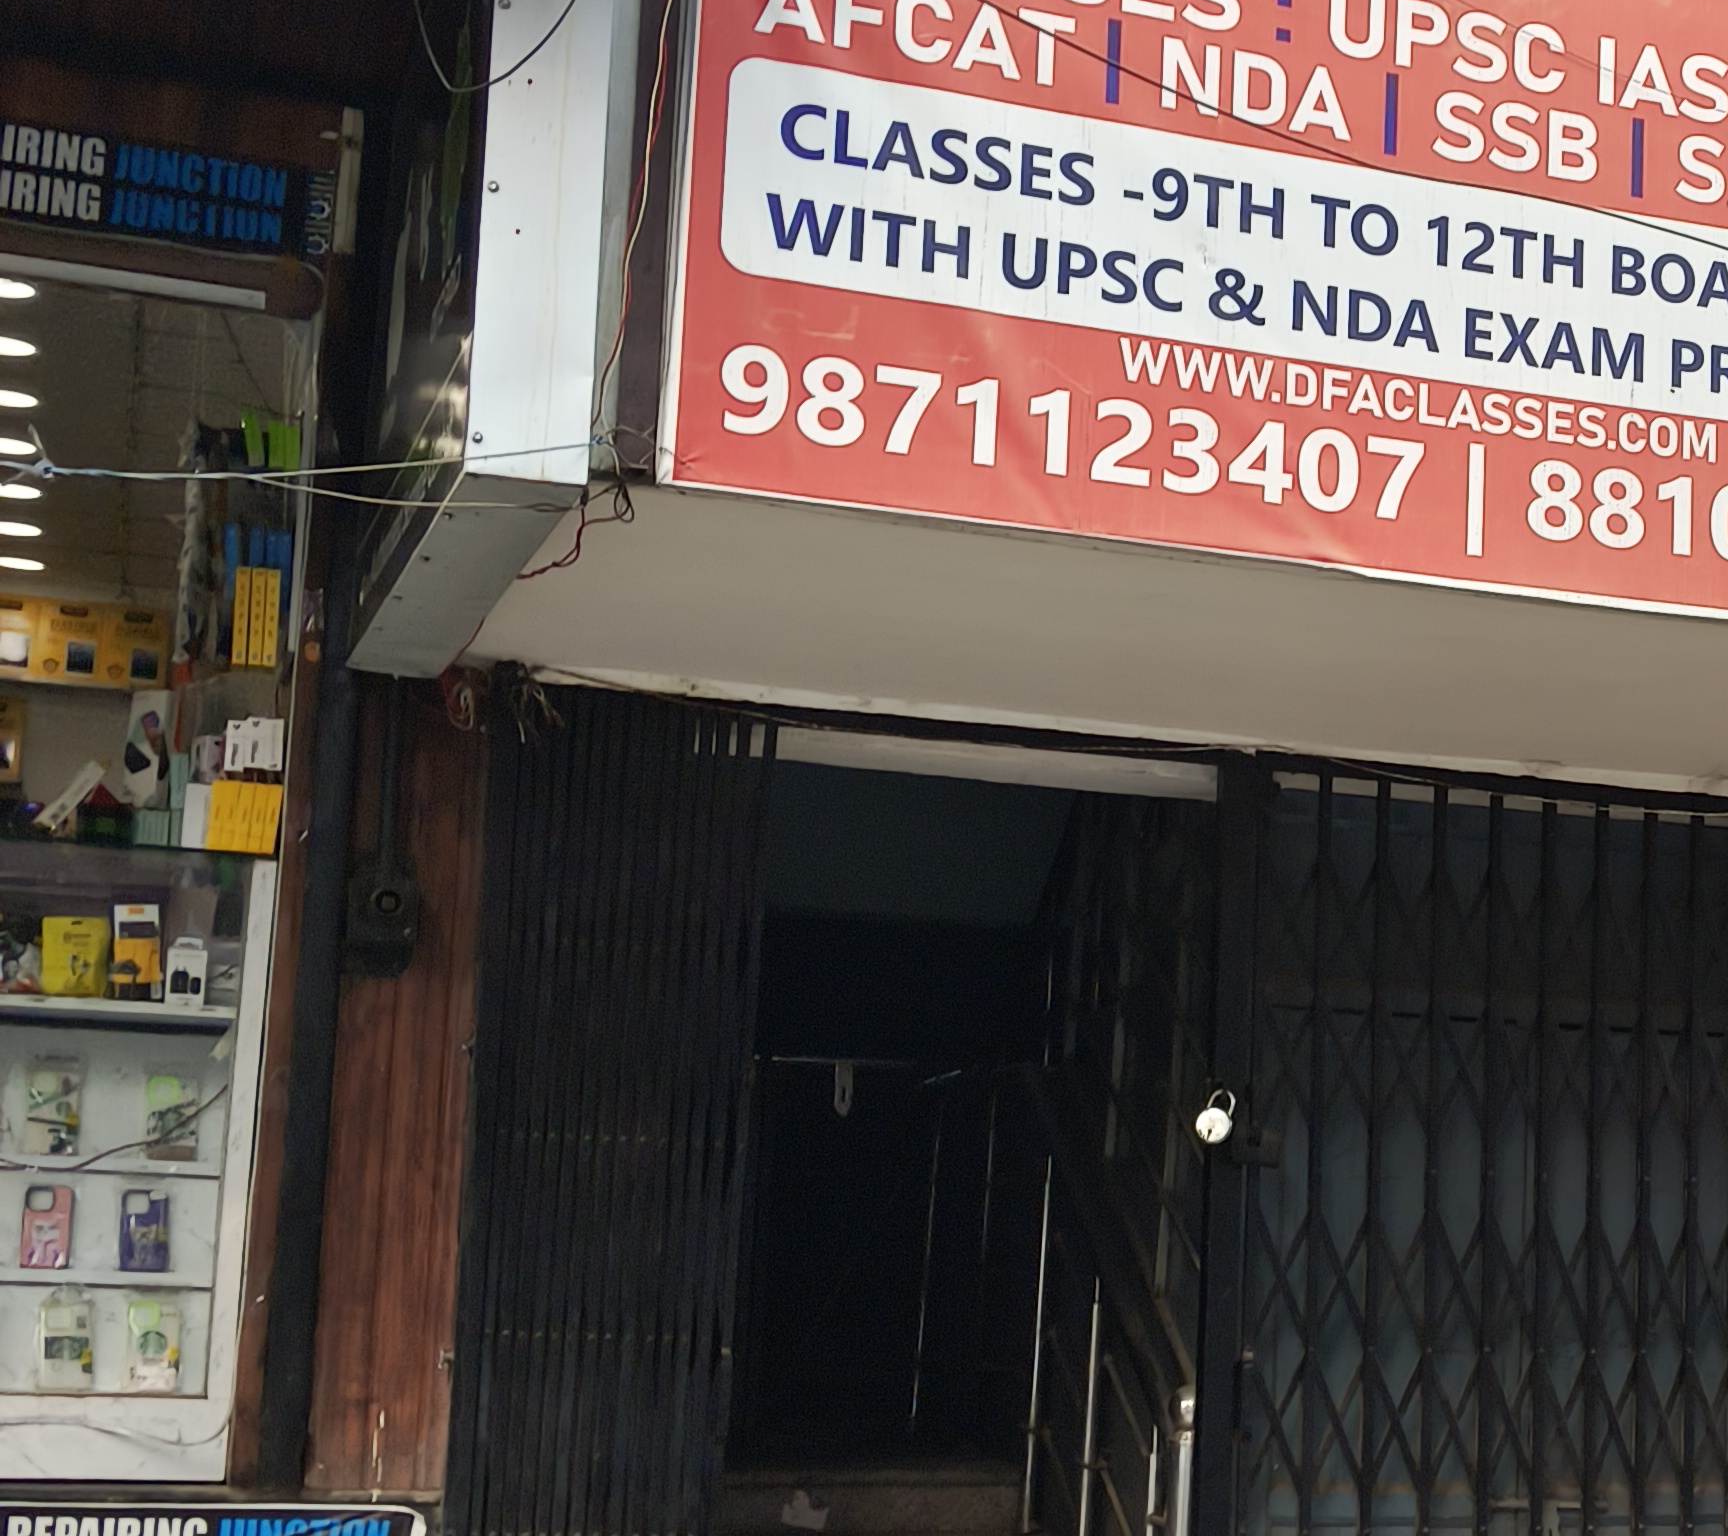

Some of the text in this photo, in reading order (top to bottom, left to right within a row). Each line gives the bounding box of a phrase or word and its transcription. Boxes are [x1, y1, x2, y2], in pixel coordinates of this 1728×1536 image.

[114, 143, 287, 207] JUNCTION
[1159, 35, 1351, 142] NDA
[1432, 91, 1599, 183] SSB
[110, 189, 282, 244] JUNCTION
[779, 103, 1096, 206] CLASSES
[1122, 167, 1286, 240] -9TH
[1310, 194, 1399, 257] TO
[1428, 215, 1584, 288] 12TH
[766, 193, 971, 279] WITH
[1001, 233, 1184, 313] UPSC
[1208, 268, 1266, 326] &
[1292, 279, 1439, 353] NDA
[1462, 309, 1648, 384] EXAM
[720, 343, 1426, 521] 9871123407
[1119, 336, 1718, 464] WWW.DFACLASSES.COM
